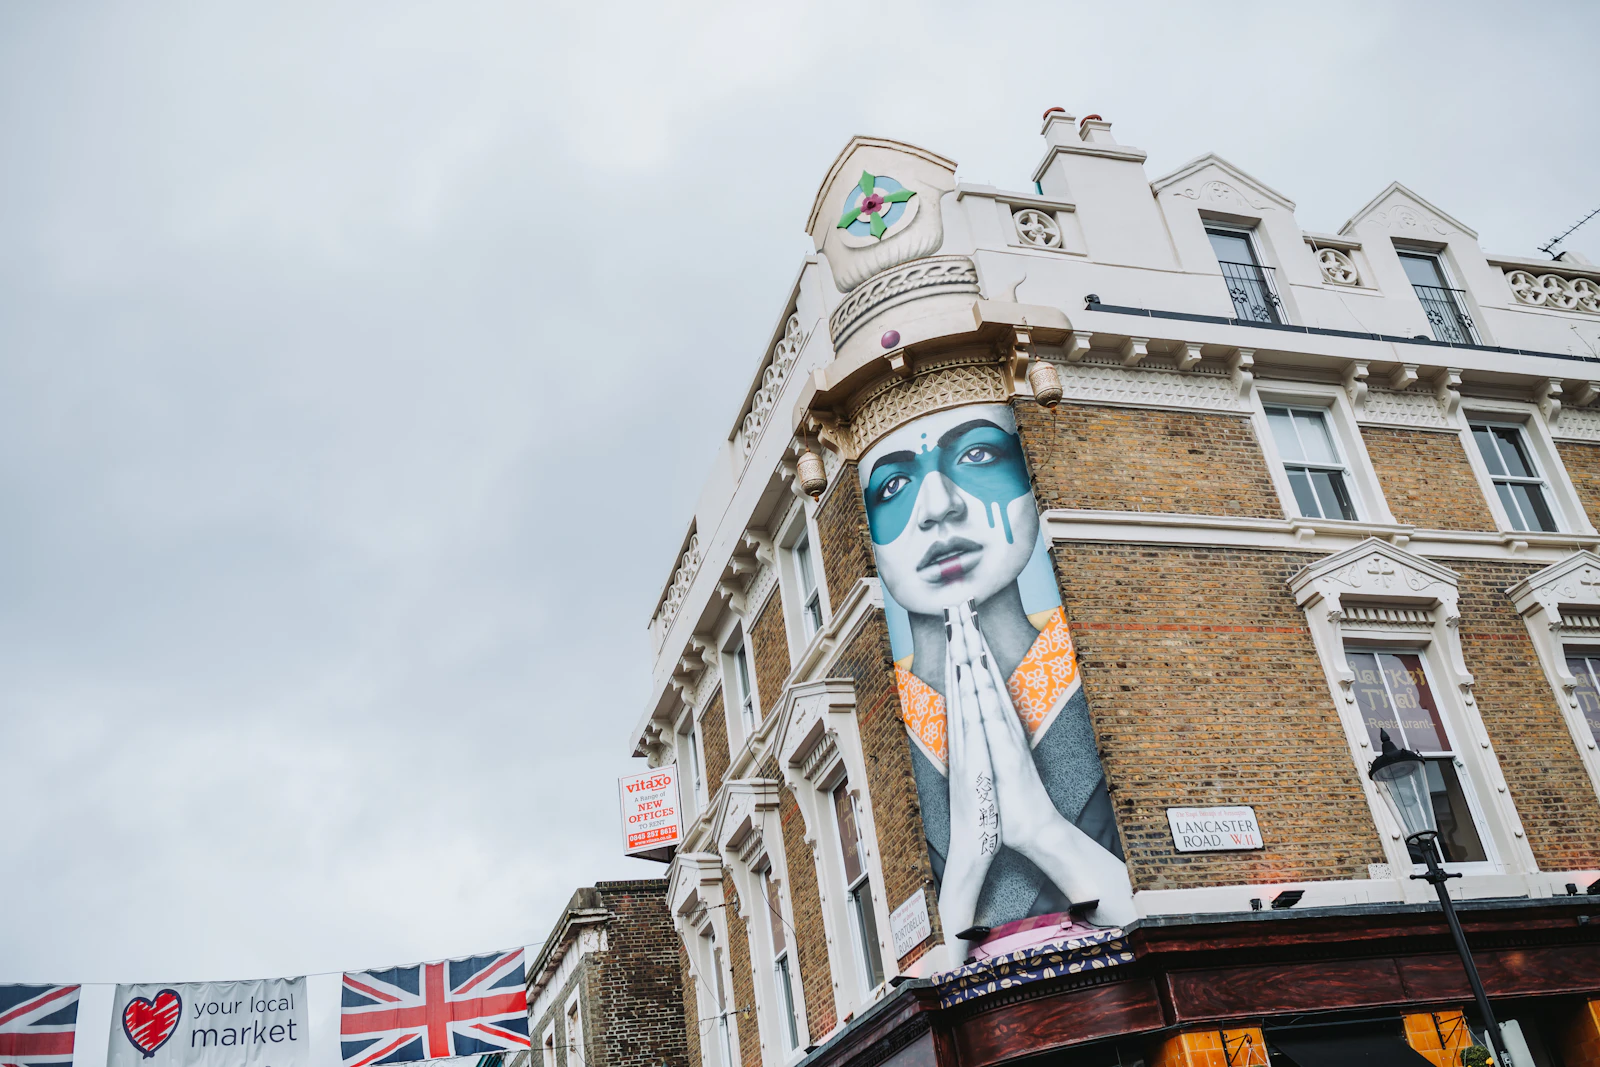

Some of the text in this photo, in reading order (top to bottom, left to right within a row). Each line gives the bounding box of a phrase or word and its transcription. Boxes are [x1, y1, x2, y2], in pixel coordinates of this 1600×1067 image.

[1361, 687, 1417, 711] Thai
[626, 774, 672, 793] vitaxo
[638, 799, 663, 812] NEW
[640, 793, 659, 802] Range
[628, 807, 675, 824] OFFICES
[638, 819, 665, 830] TO RENT
[1176, 819, 1255, 834] LANCASTER
[894, 911, 926, 943] PORTOBELLO
[193, 993, 294, 1019] your local
[191, 1019, 298, 1048] market
